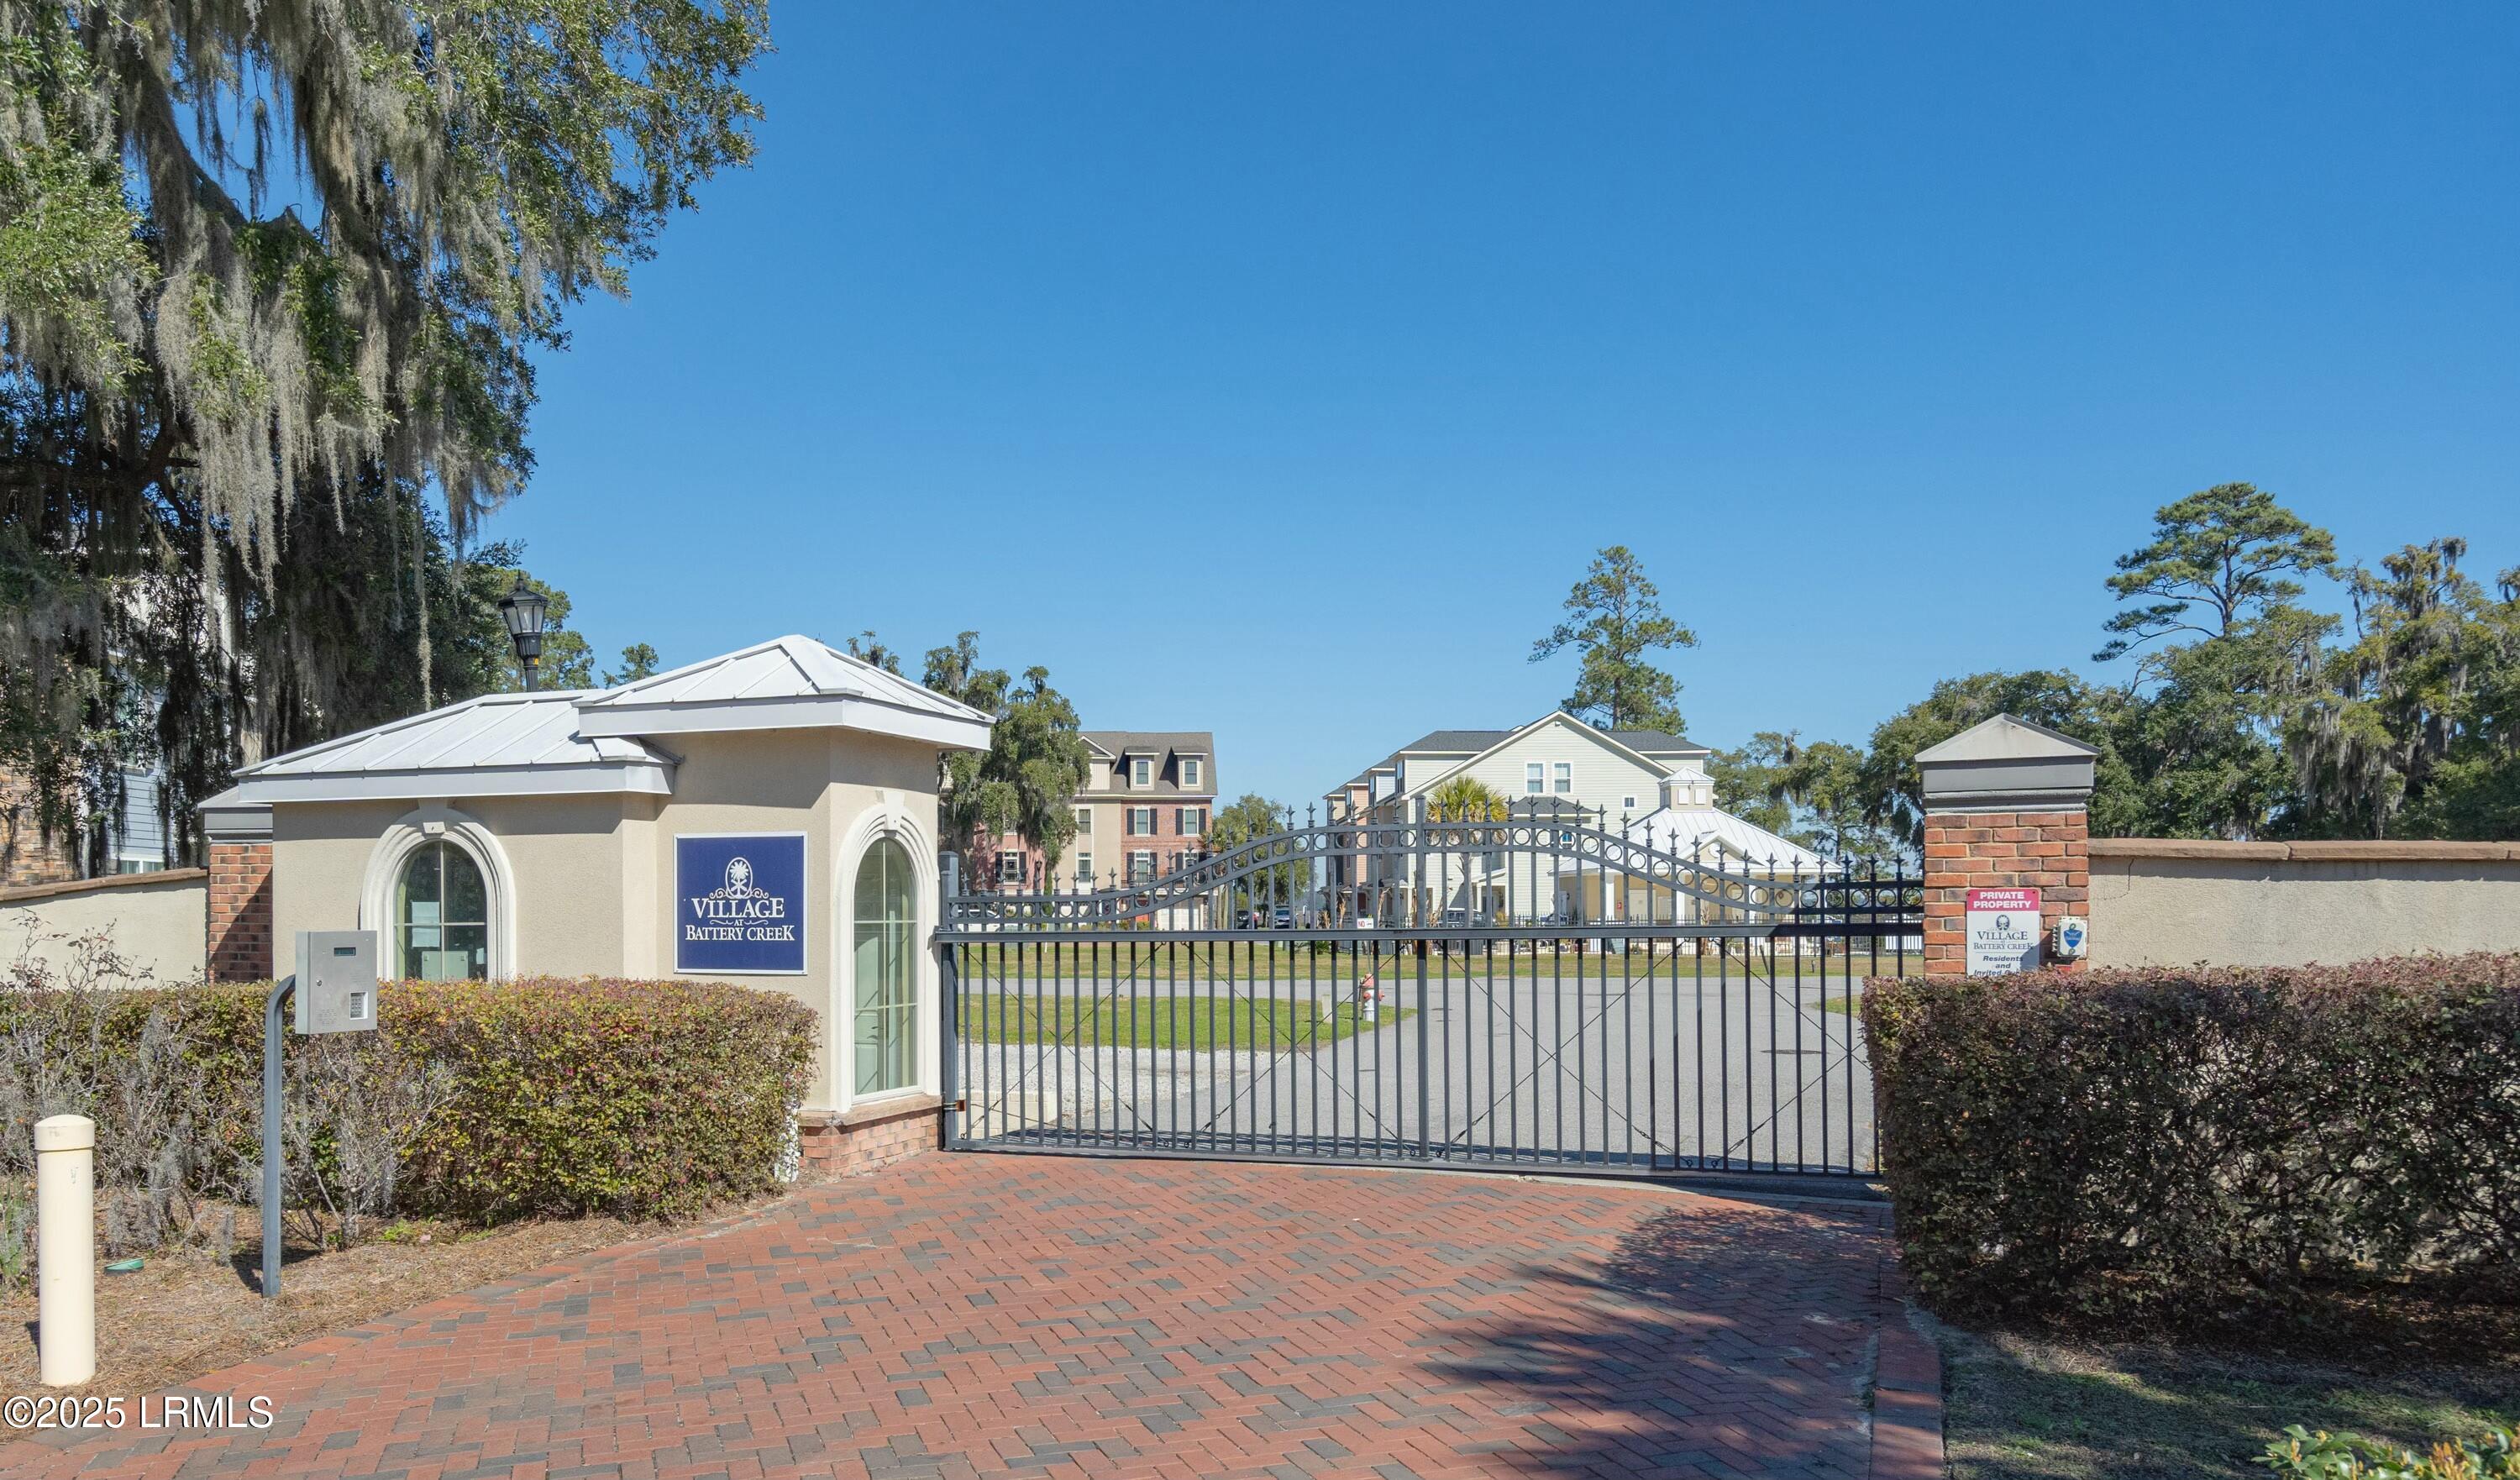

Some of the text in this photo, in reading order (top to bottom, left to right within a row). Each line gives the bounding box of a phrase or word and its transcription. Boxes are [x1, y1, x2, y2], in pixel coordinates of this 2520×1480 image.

[691, 898, 785, 918] VILLAGE
[685, 925, 795, 941] BATTERY CREEK
[1977, 932, 2028, 940] VILLAGE
